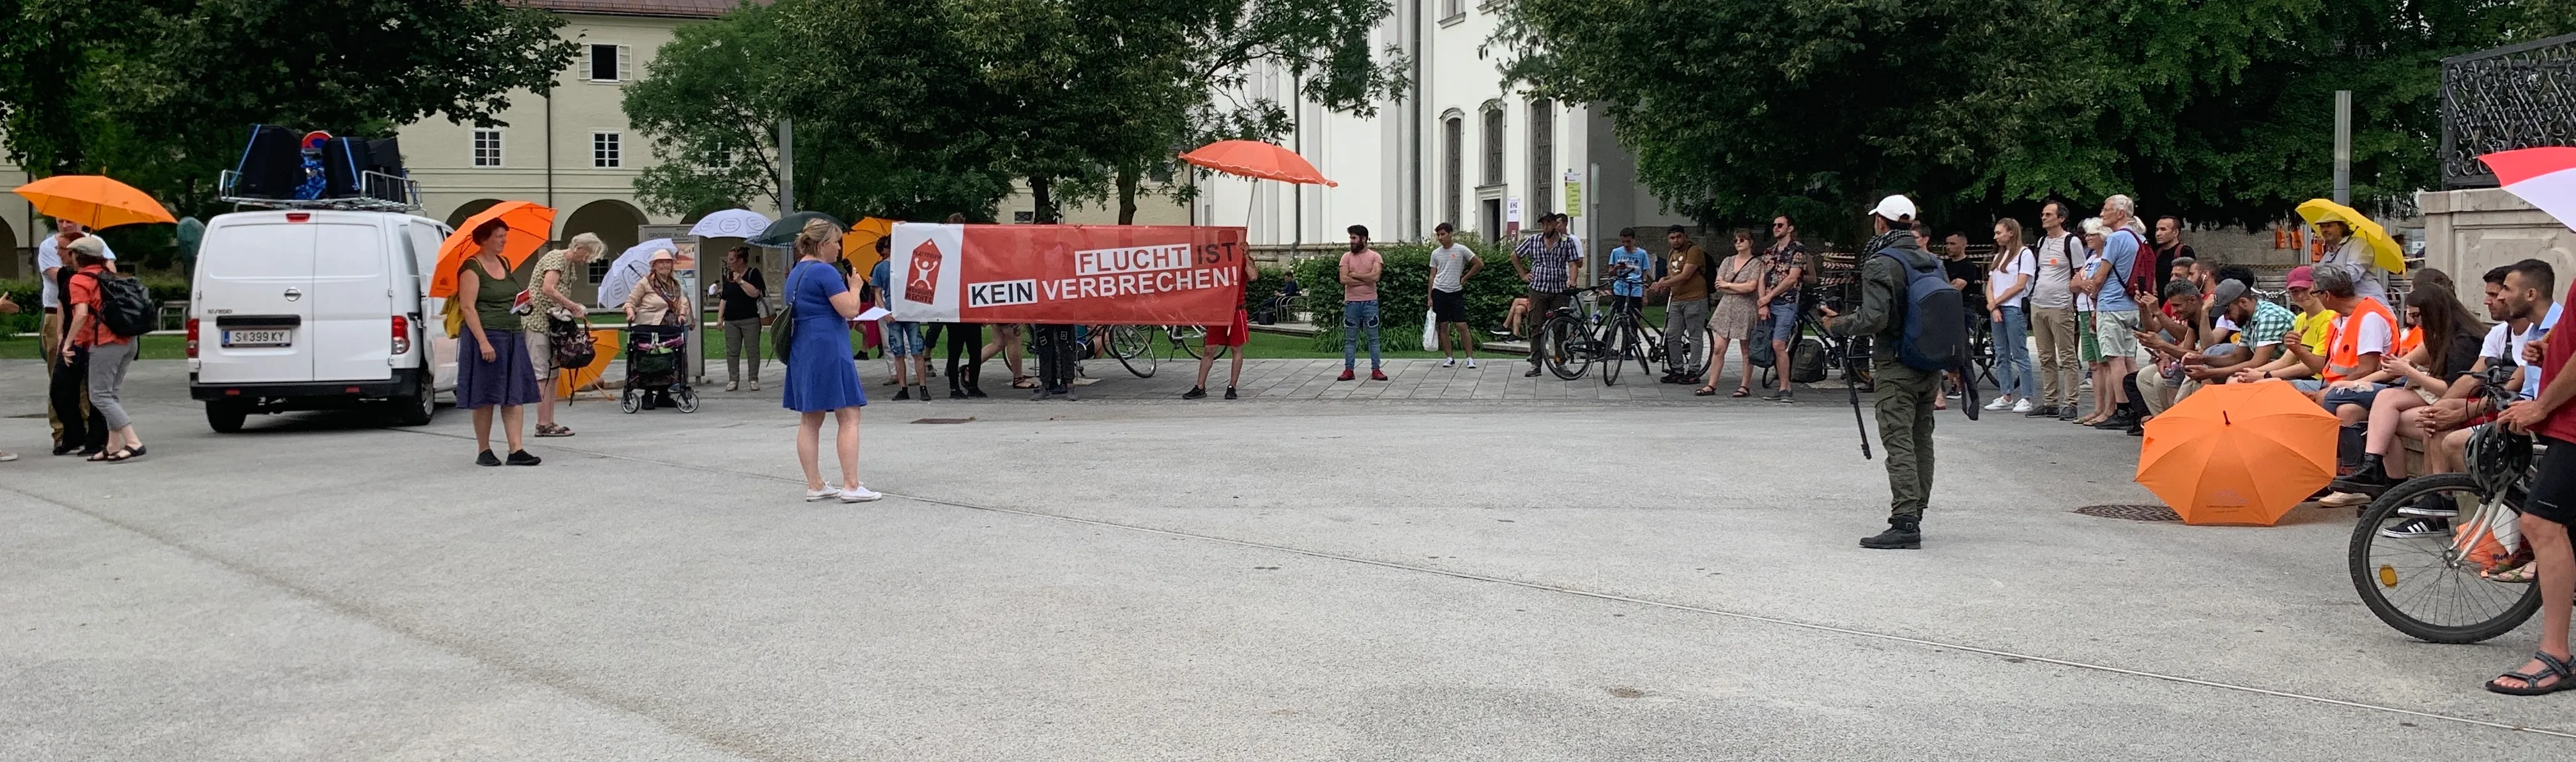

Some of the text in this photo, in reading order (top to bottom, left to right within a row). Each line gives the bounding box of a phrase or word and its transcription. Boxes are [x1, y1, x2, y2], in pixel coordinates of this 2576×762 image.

[1079, 242, 1236, 273] FLUCHT IST
[972, 266, 1238, 306] KEIN VERBRECHEN!
[905, 292, 933, 304] RECHTE
[235, 332, 284, 342] S 399 KY
